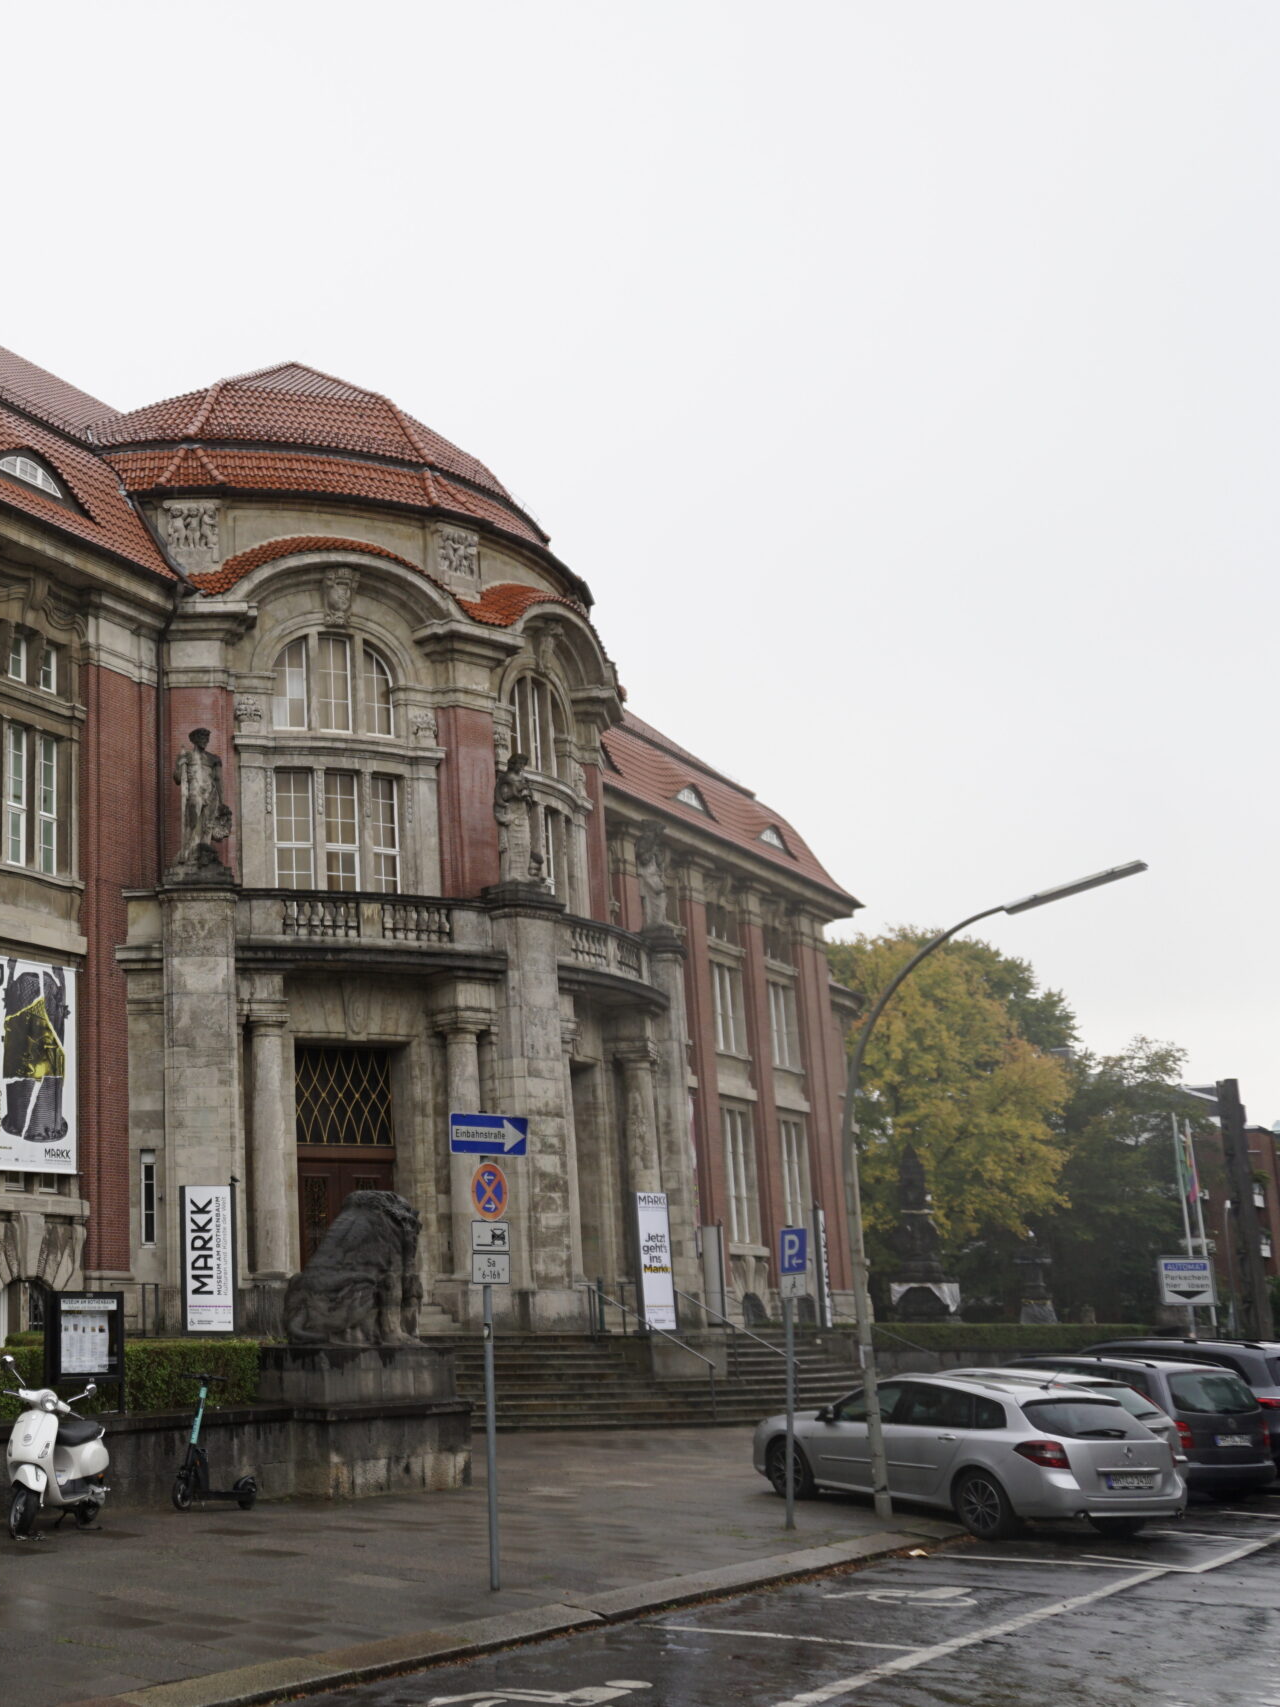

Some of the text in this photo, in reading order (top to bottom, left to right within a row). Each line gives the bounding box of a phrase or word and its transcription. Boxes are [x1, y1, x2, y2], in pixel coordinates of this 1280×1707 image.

[455, 1128, 506, 1140] Einbahnstraße
[44, 1148, 71, 1160] MARKK
[645, 1233, 665, 1243] Jetzt
[190, 1197, 214, 1295] MARKK
[784, 1234, 800, 1268] P
[215, 1250, 221, 1262] AM
[487, 1257, 496, 1267] Sa
[649, 1253, 662, 1263] ins
